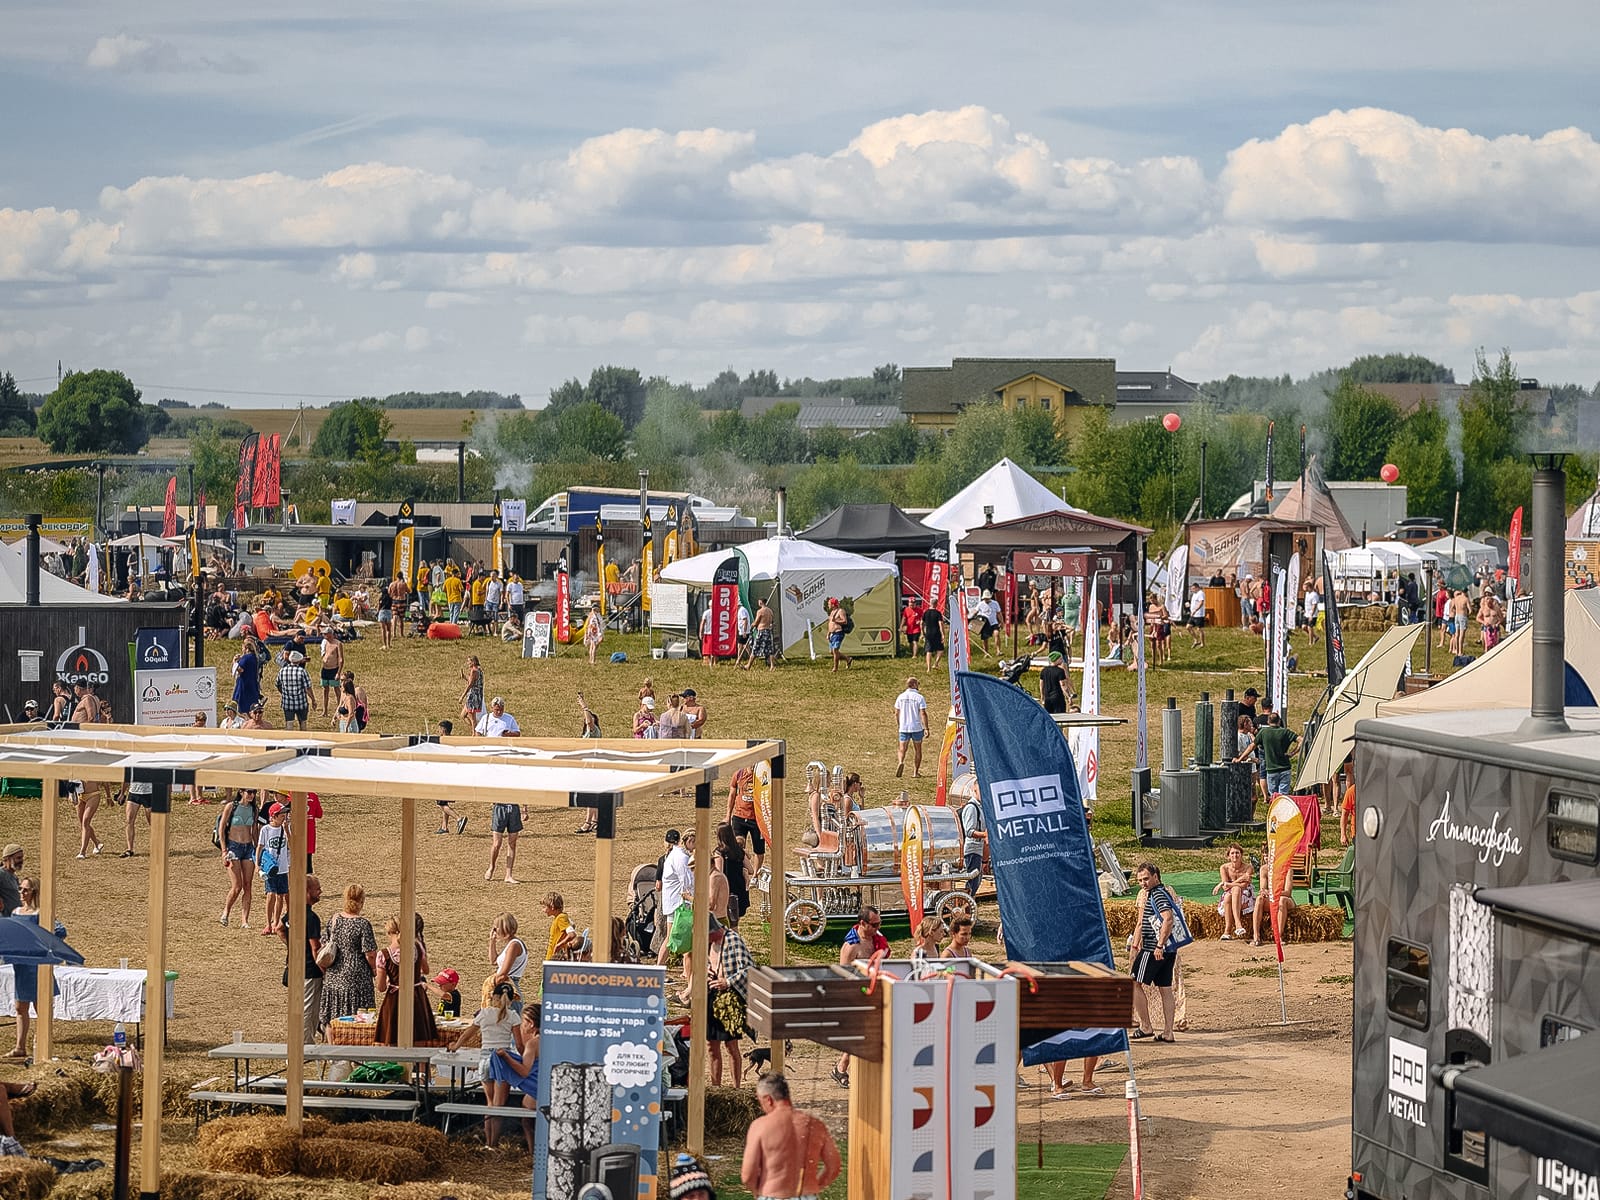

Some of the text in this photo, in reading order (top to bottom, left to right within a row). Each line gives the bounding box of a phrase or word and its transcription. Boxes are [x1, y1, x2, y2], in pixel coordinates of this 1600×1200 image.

[1214, 533, 1240, 554] БАНЯ
[400, 536, 411, 583] ВЕЗУВИ
[803, 578, 825, 601] БАНЯ
[719, 588, 731, 642] VVD.SU
[997, 785, 1059, 811] PRO
[996, 814, 1070, 840] METALL
[1426, 791, 1522, 866] Атмосфера
[550, 973, 661, 988] АТМОСФЕРА 2XL
[545, 1001, 552, 1010] 2
[553, 1003, 593, 1011] каменки
[553, 1014, 560, 1022] 2
[561, 1015, 583, 1024] раза
[584, 1015, 620, 1025] больше
[622, 1018, 645, 1027] пара
[584, 1029, 598, 1038] до
[1392, 1054, 1424, 1086] PRO
[1387, 1093, 1427, 1128] METALL
[1536, 1156, 1600, 1200] ПЕРВА
